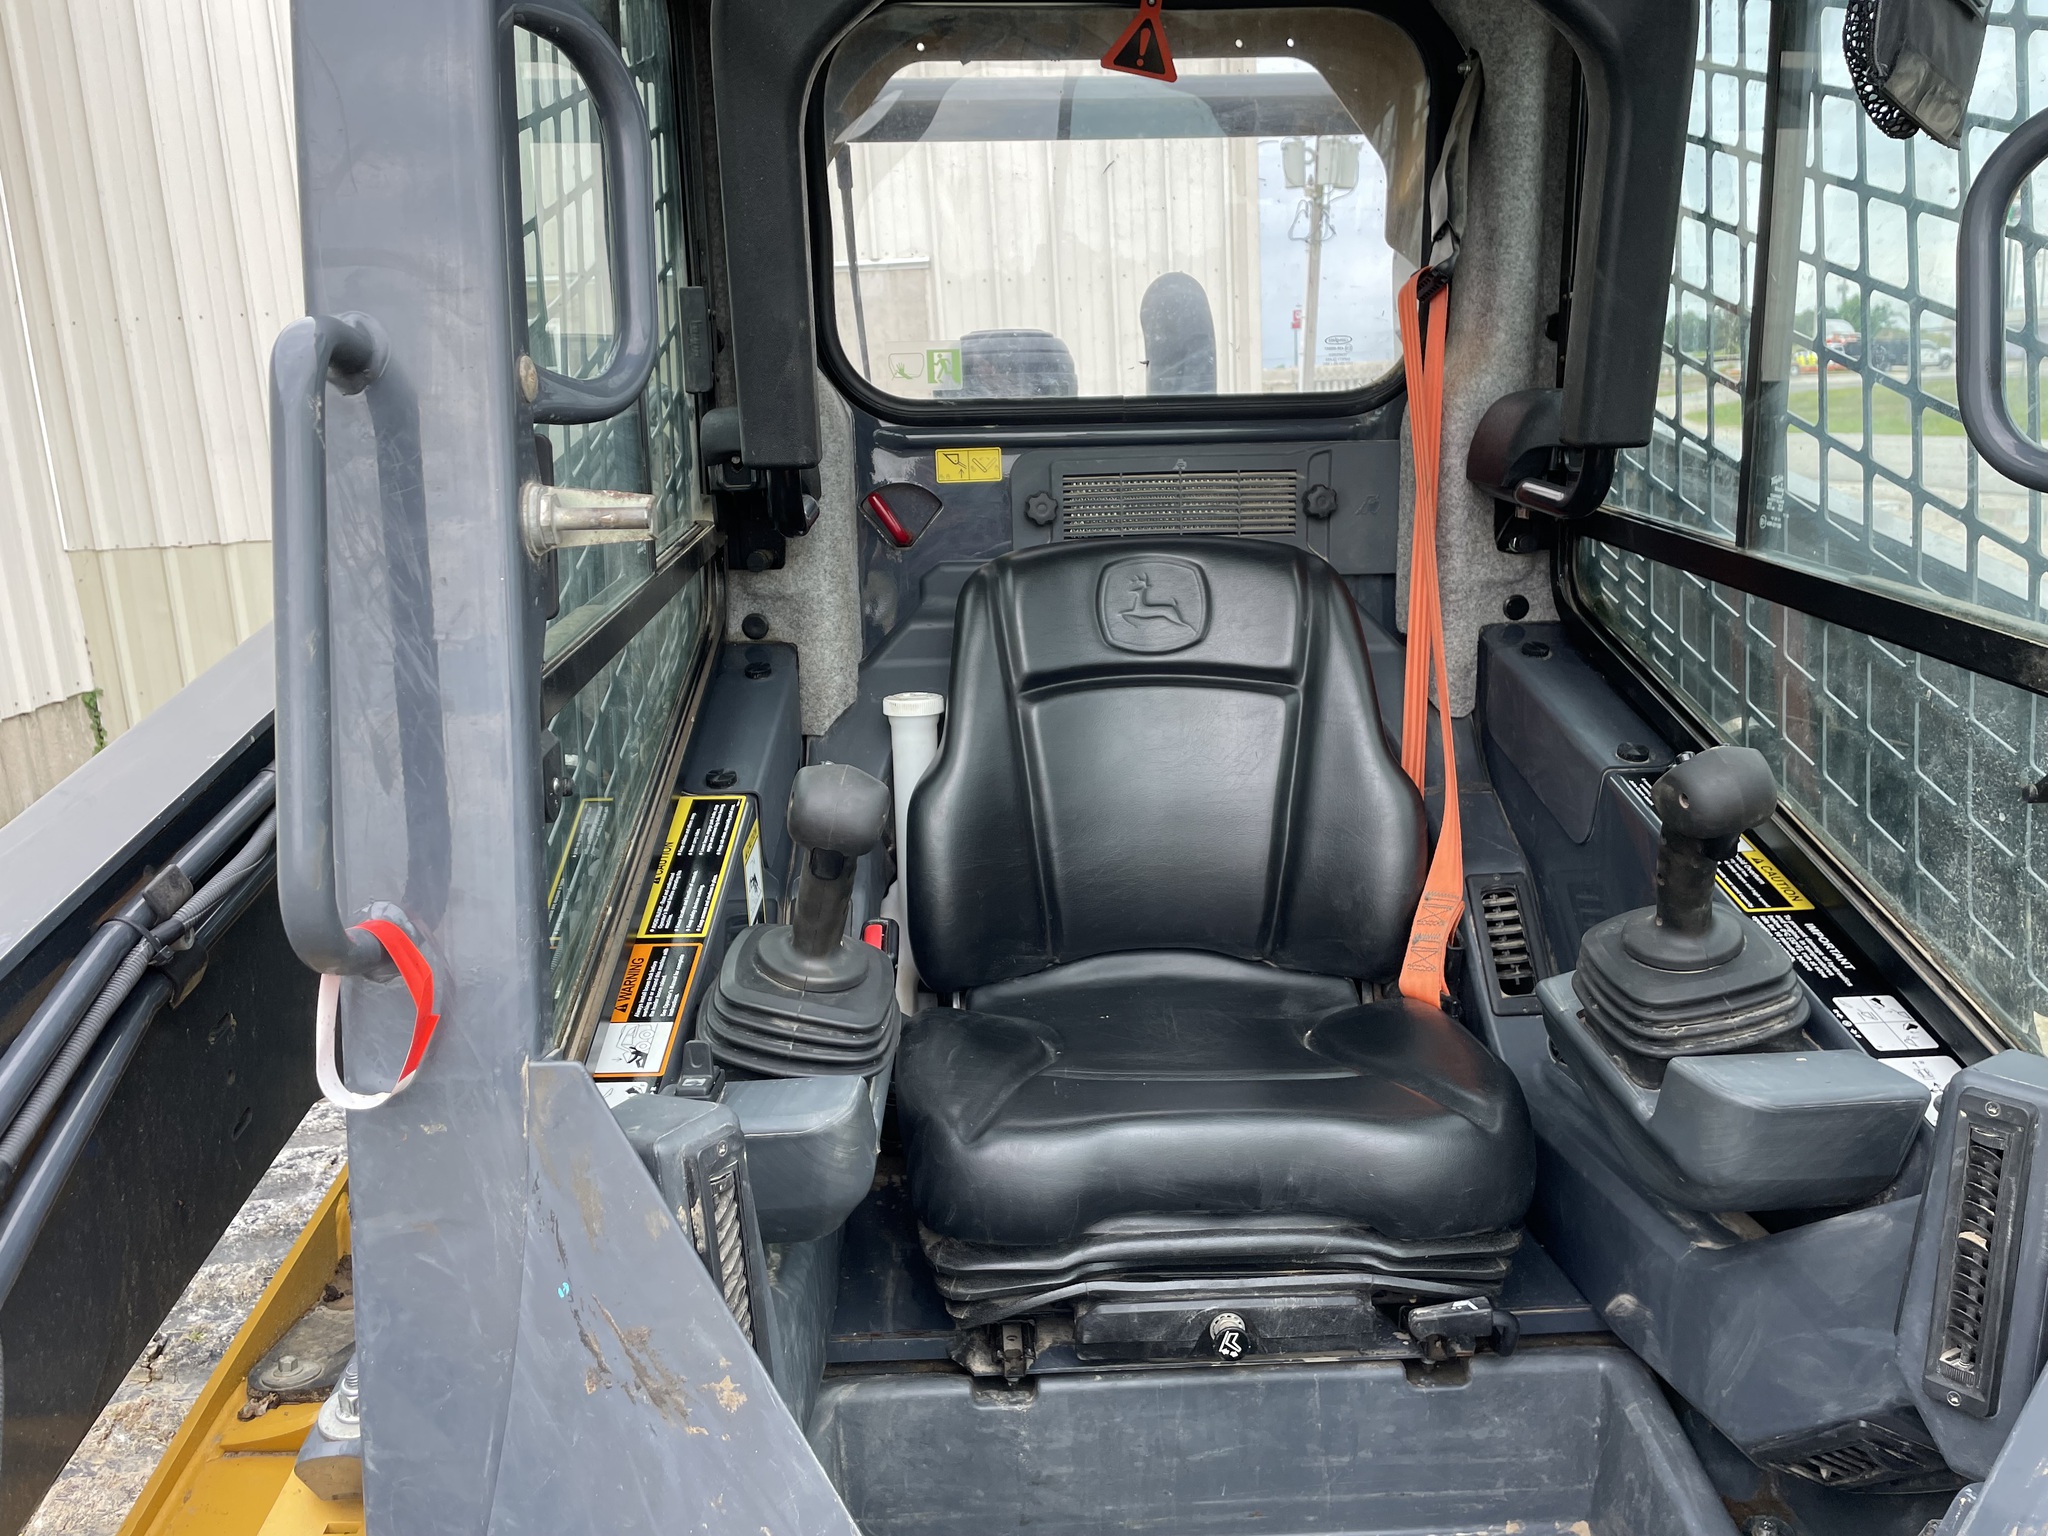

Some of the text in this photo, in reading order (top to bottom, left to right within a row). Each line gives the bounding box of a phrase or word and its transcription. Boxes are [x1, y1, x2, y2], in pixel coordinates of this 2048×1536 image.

[656, 841, 674, 875] CAUTION
[1761, 865, 1803, 902] CAUTION
[1804, 923, 1856, 970] IMPORTANT
[618, 957, 645, 1002] WARNING
